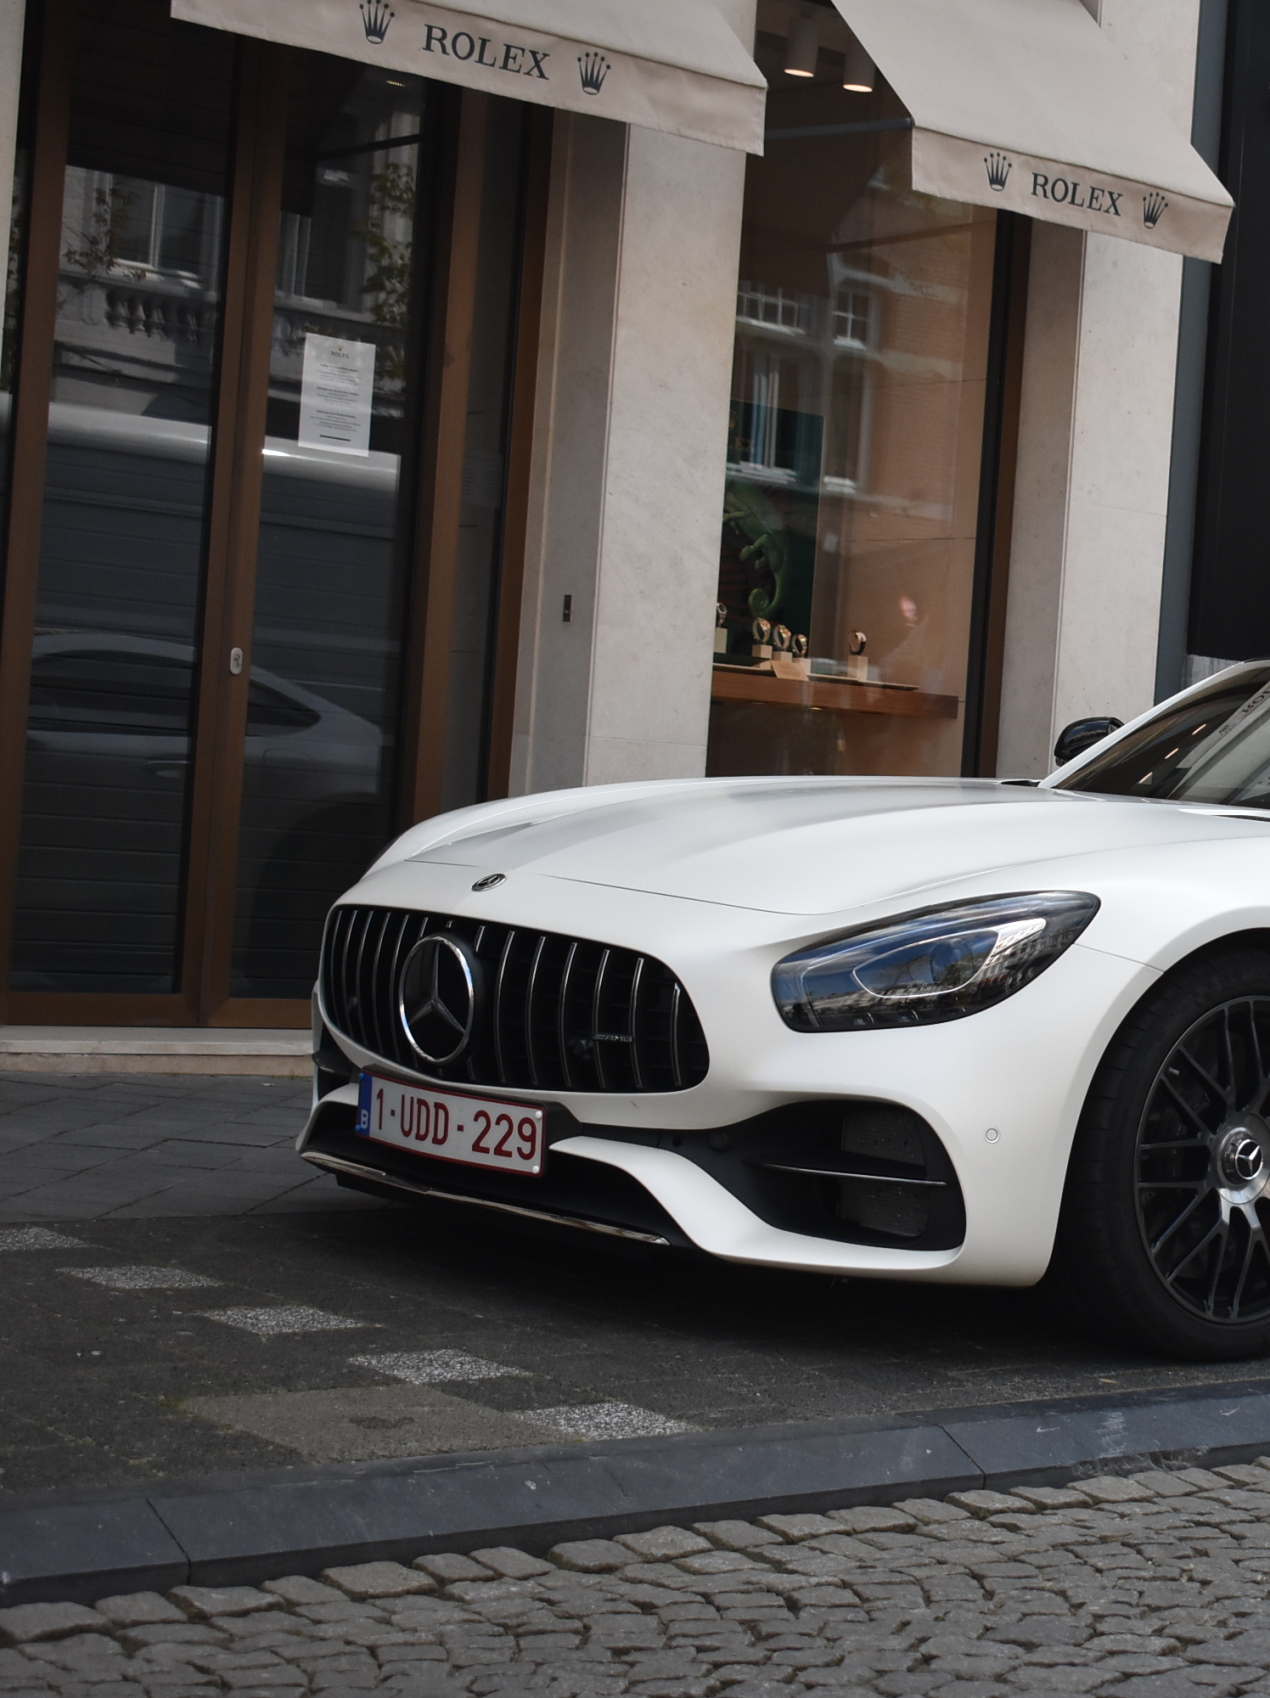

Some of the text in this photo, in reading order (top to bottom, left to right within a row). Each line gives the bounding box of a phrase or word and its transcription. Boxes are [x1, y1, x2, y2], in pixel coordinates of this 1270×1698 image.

[422, 23, 551, 82] ROLEX
[1031, 172, 1124, 218] ROLEX
[360, 1109, 369, 1129] B
[376, 1088, 537, 1160] 1-UDD-229
